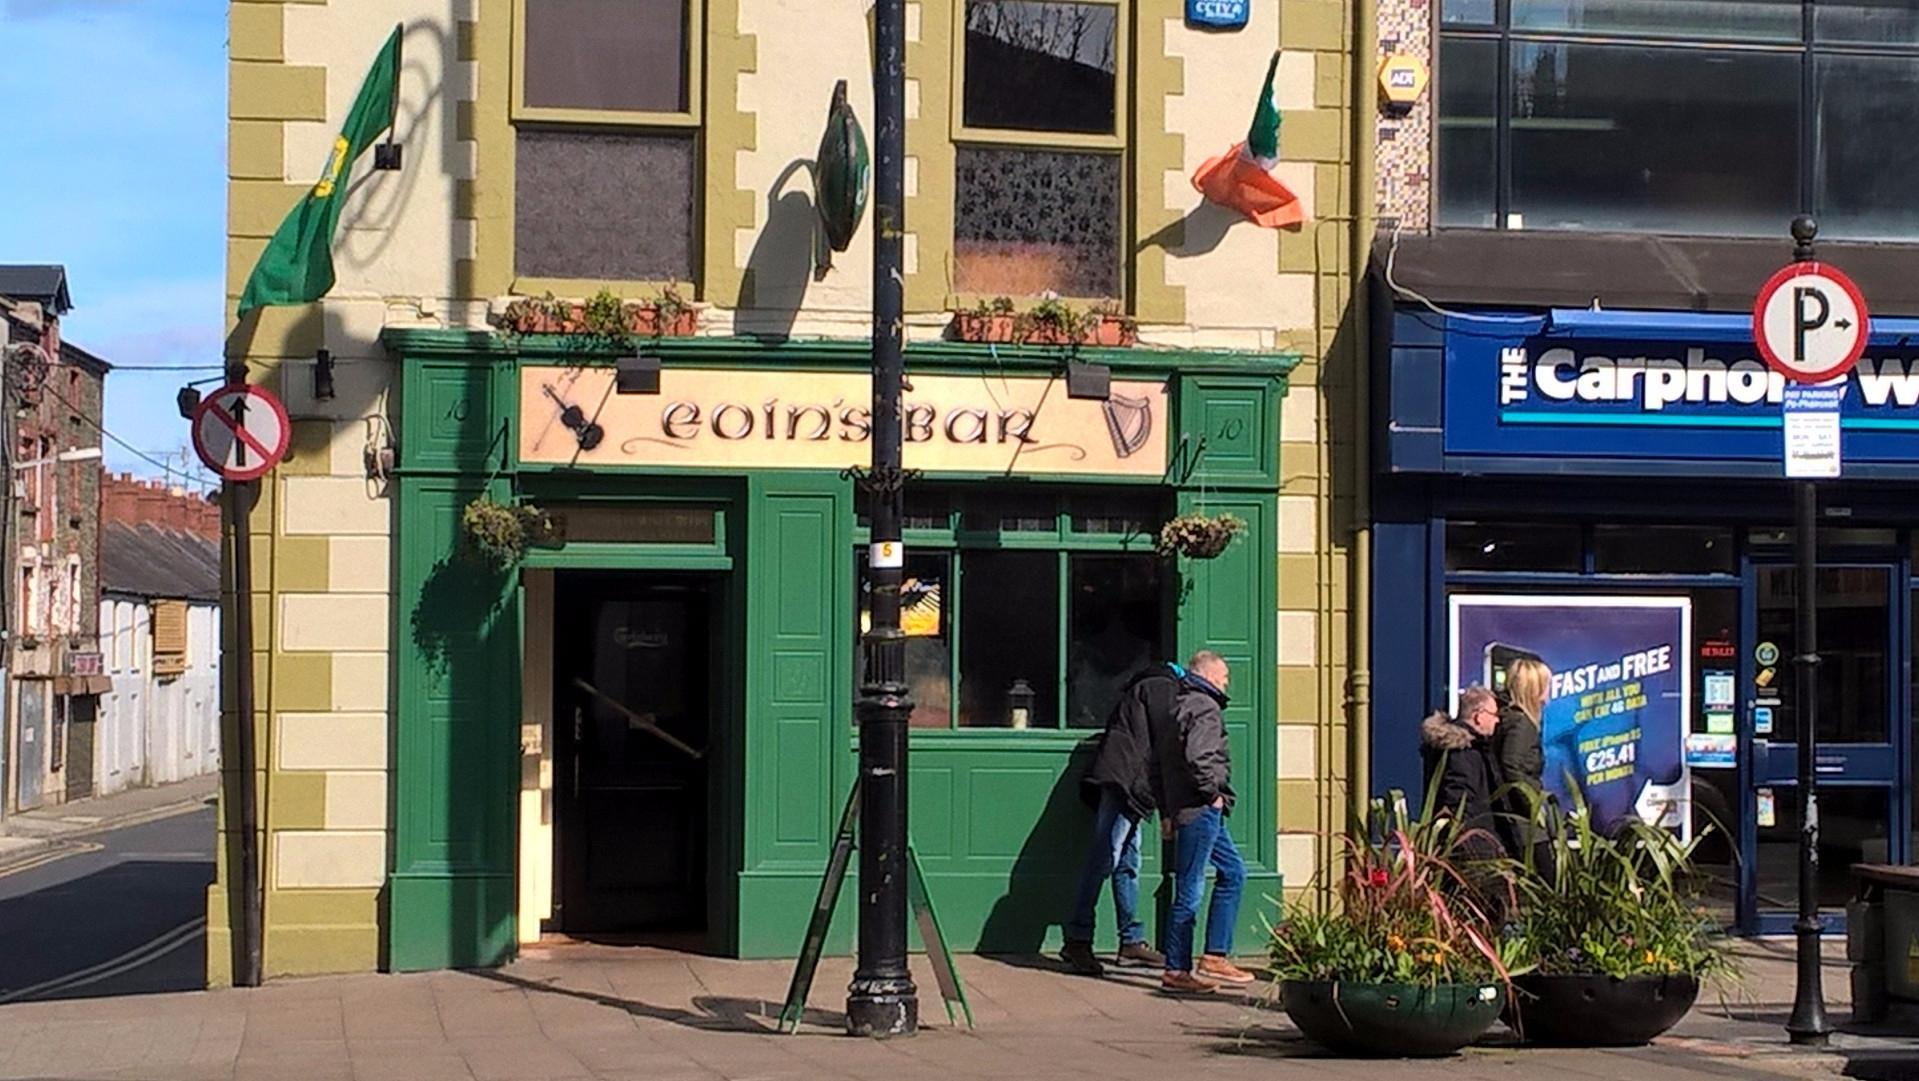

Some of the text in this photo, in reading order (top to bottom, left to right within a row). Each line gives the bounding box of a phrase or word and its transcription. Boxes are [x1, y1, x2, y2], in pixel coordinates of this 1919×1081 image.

[1391, 72, 1414, 85] ADT
[1793, 286, 1830, 362] P
[1502, 348, 1527, 404] THE
[1535, 348, 1848, 411] Carpho
[883, 543, 892, 557] 5
[1551, 645, 1671, 699] FAST AND FREE
[1586, 742, 1635, 773] €25.41
